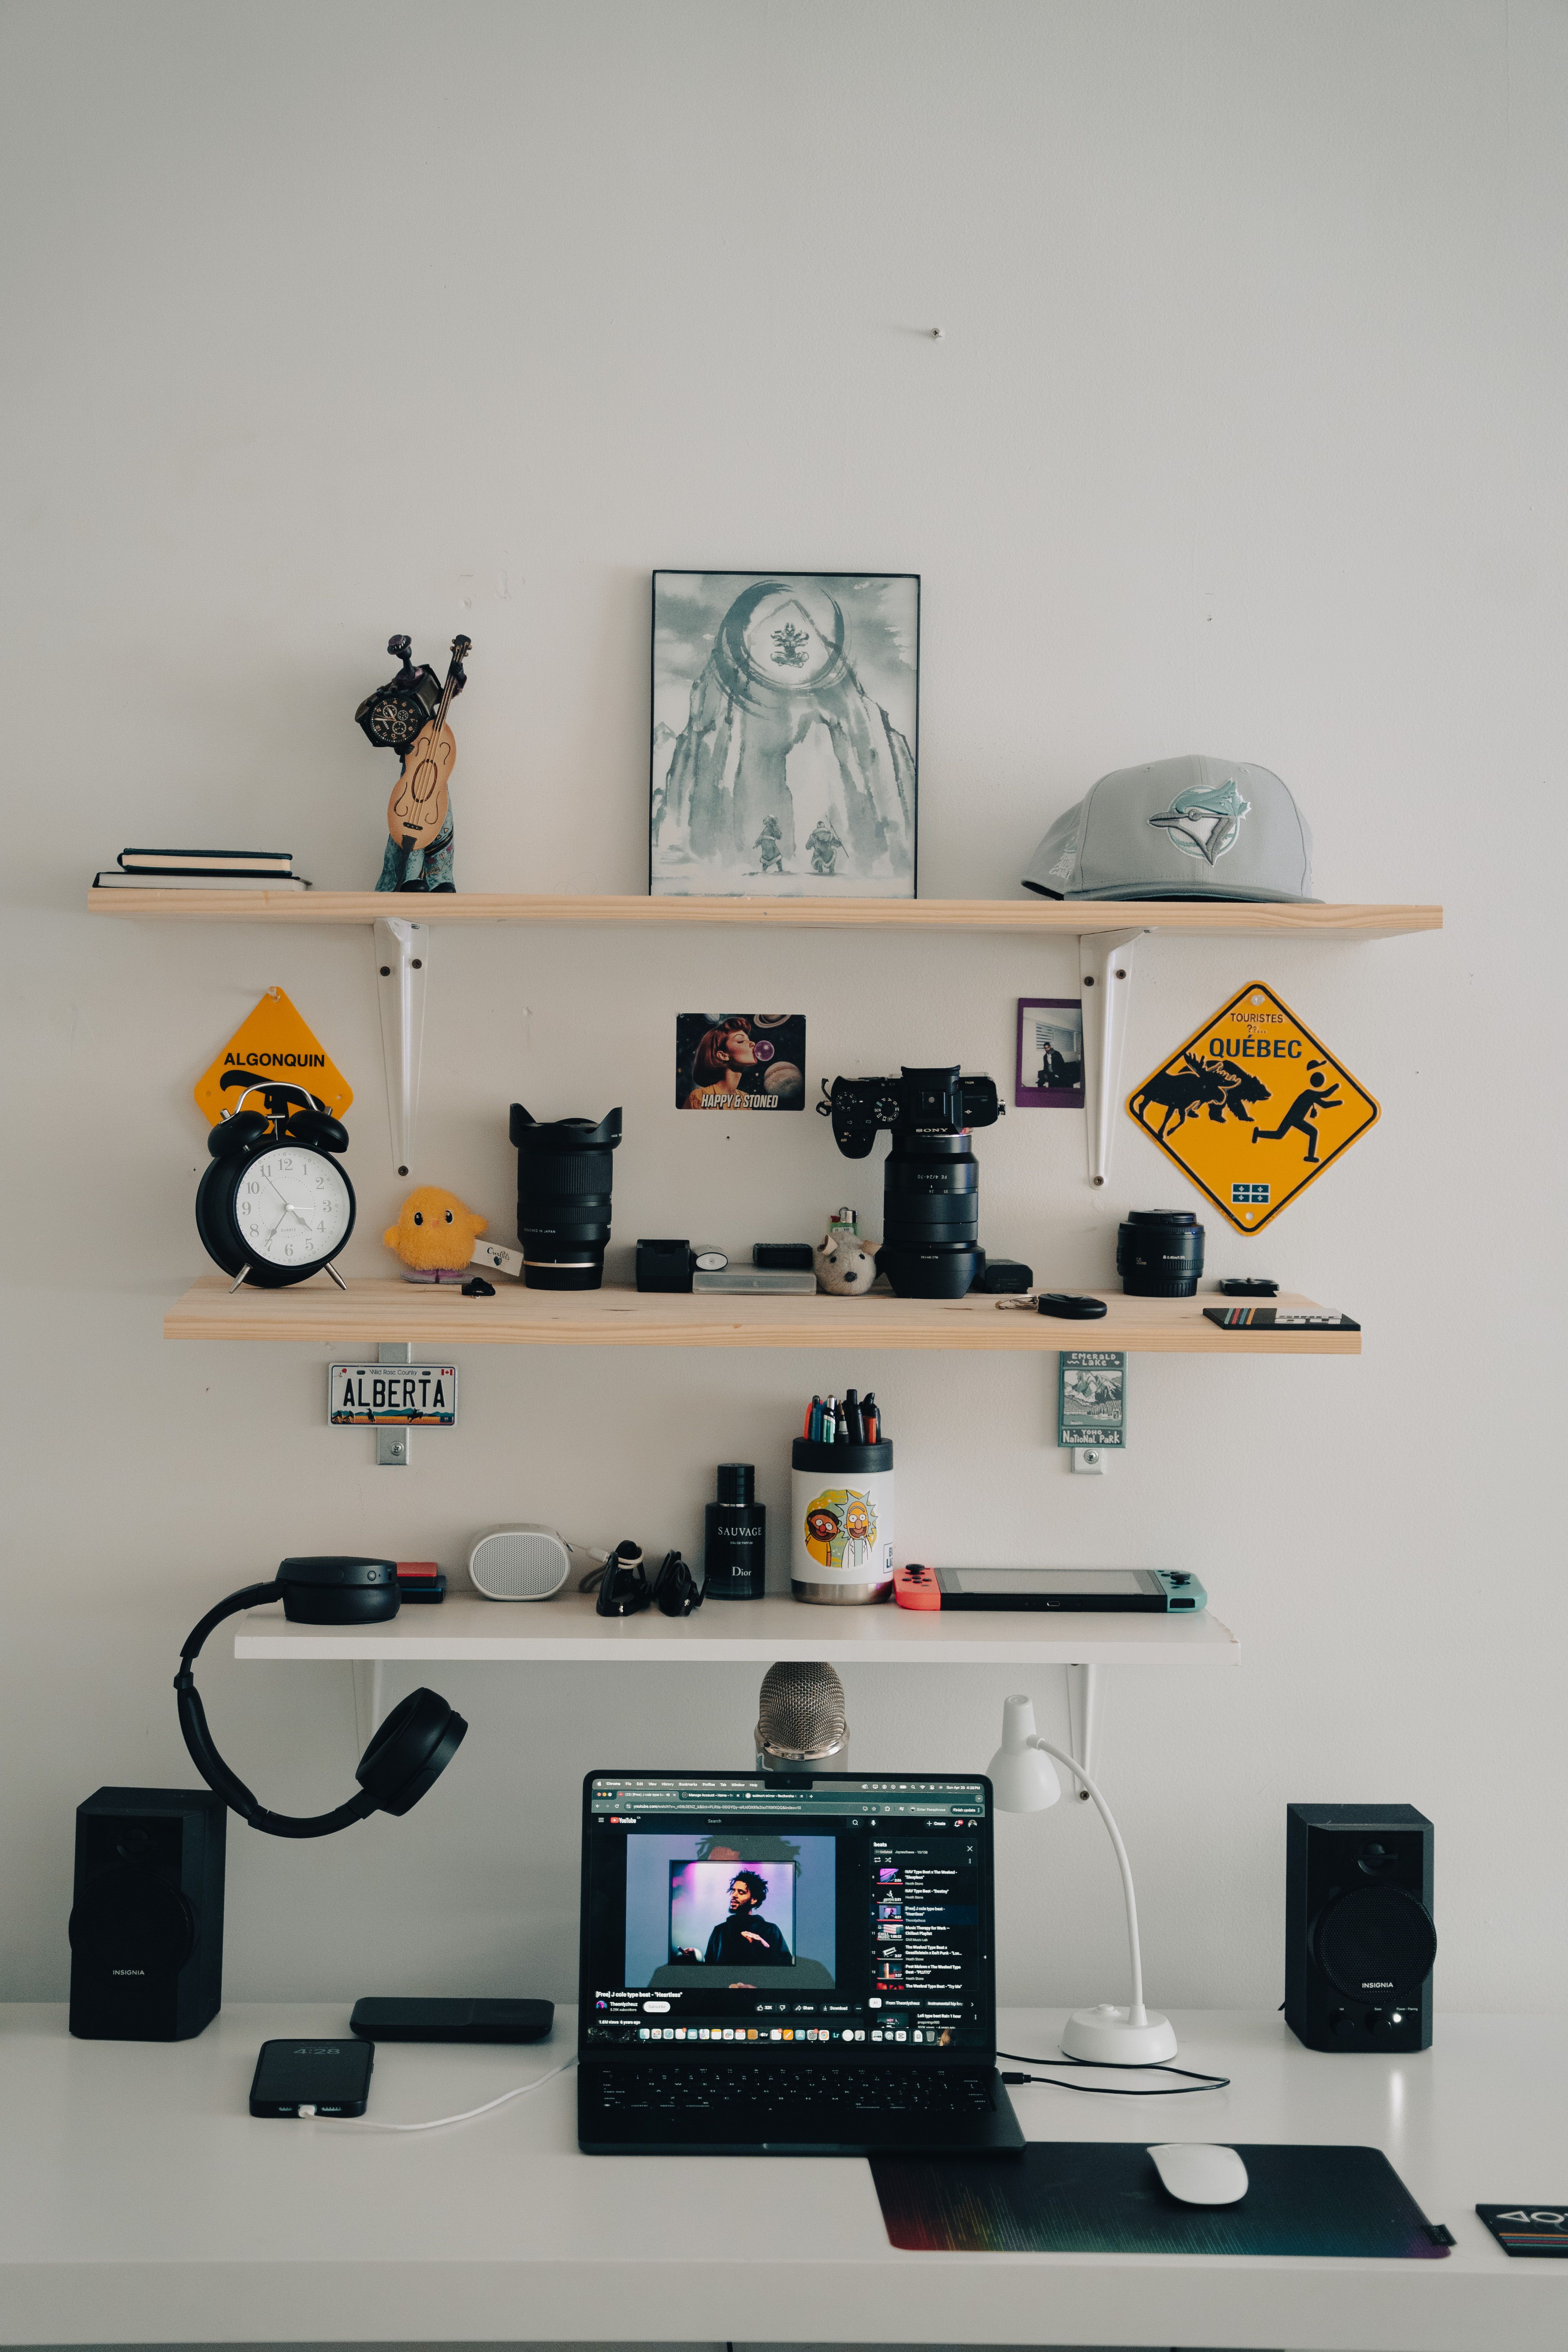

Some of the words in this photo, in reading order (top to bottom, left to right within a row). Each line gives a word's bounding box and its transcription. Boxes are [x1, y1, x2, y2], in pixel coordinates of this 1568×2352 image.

[1230, 1013, 1283, 1023] TOURISTES
[1209, 1034, 1302, 1058] QUÉBEC
[223, 1052, 325, 1067] ALGONQUIN
[701, 1094, 734, 1107] HAPPY
[734, 1094, 741, 1107] &
[742, 1094, 779, 1108] STONED
[278, 1158, 293, 1171] 12
[302, 1163, 309, 1176] 1
[247, 1181, 260, 1195] 10
[316, 1176, 325, 1190] 2
[241, 1201, 251, 1216] 9
[323, 1200, 332, 1213] 3
[250, 1223, 259, 1237] 8
[316, 1220, 326, 1233] 4
[284, 1243, 294, 1256] 6
[305, 1238, 314, 1251] 5
[343, 1378, 445, 1408] ALBERTA
[718, 1526, 762, 1536] SAUVAGE
[732, 1566, 751, 1576] Dior
